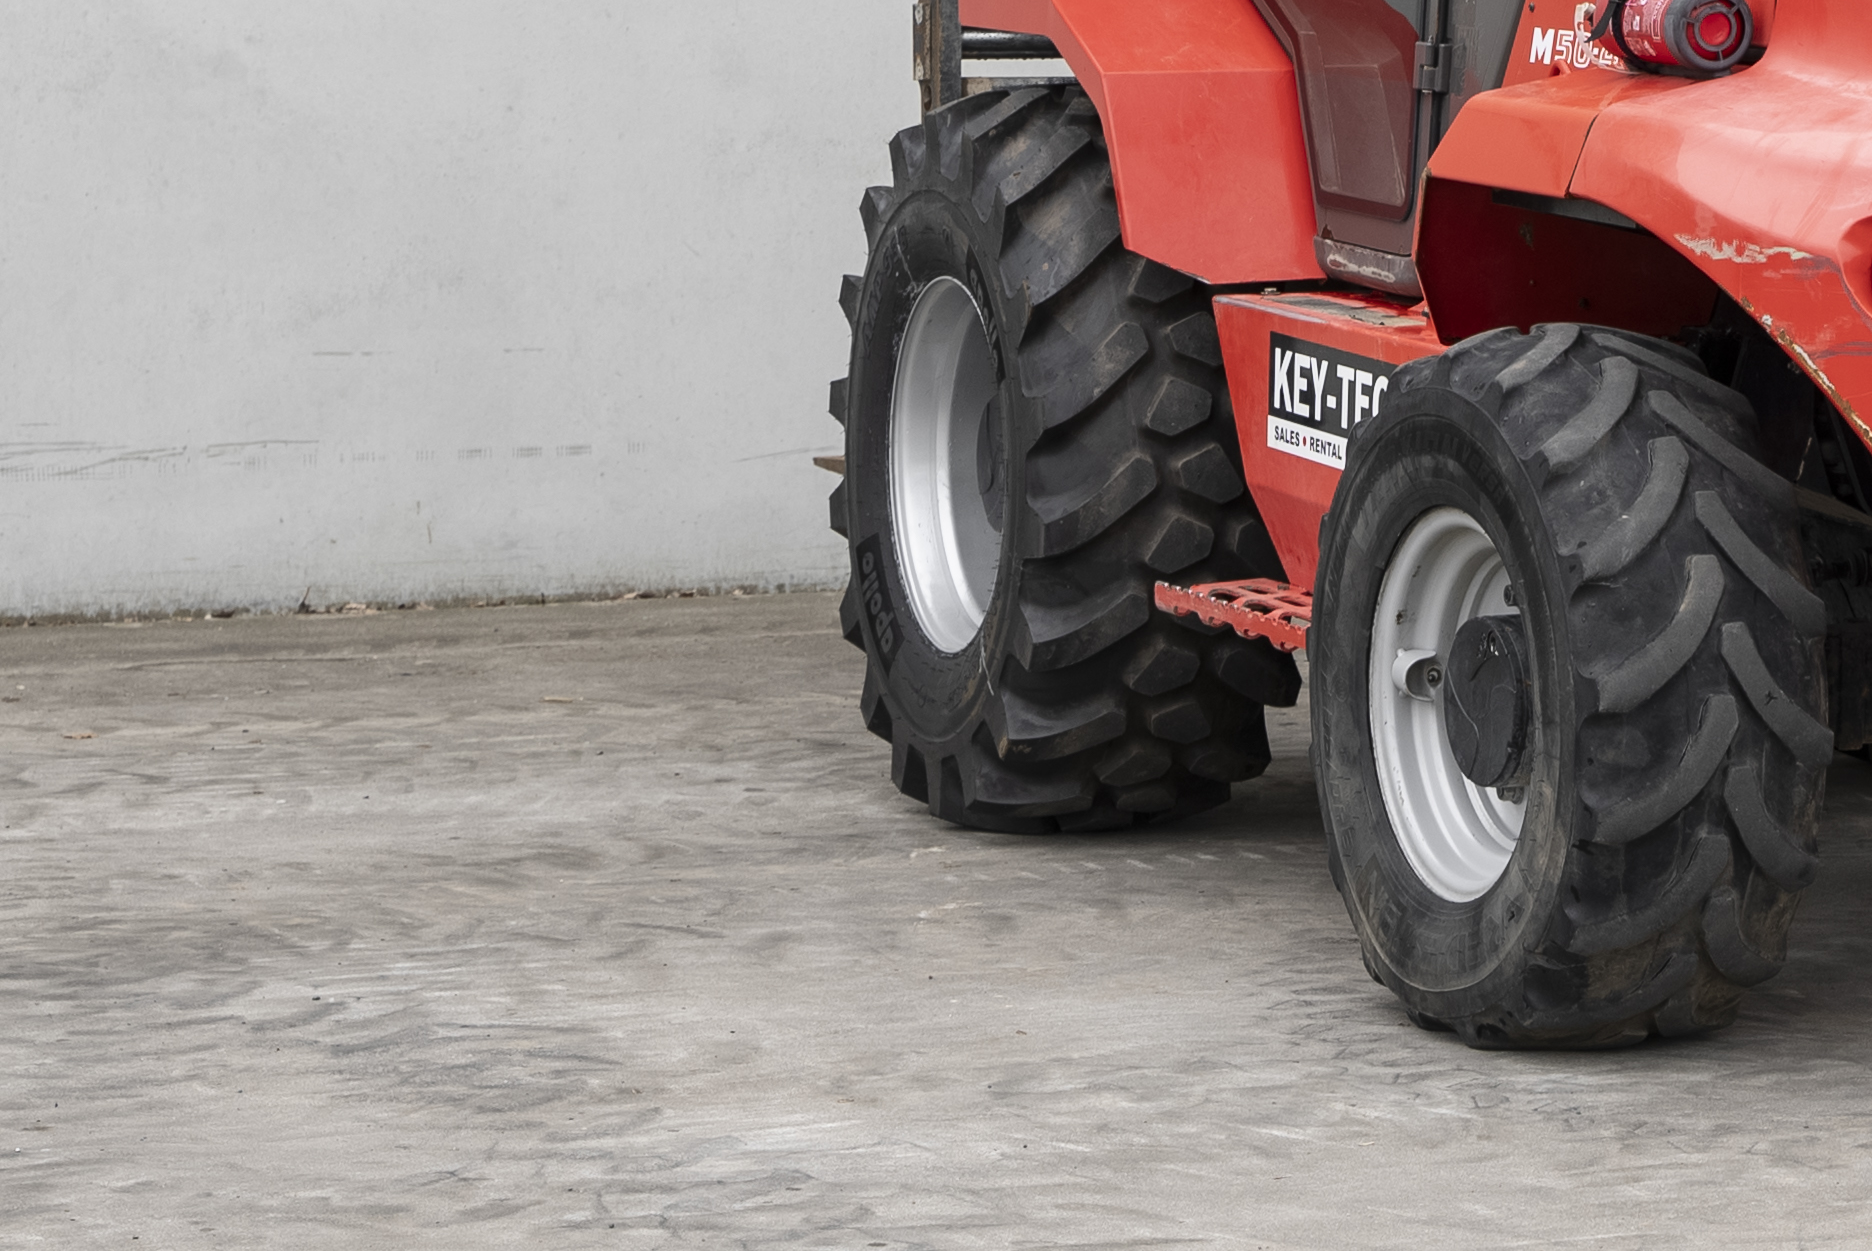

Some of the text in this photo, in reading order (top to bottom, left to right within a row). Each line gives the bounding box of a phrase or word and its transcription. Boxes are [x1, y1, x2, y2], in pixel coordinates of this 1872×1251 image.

[1274, 425, 1343, 461] SALES RENTAL
[861, 551, 895, 654] apollo
